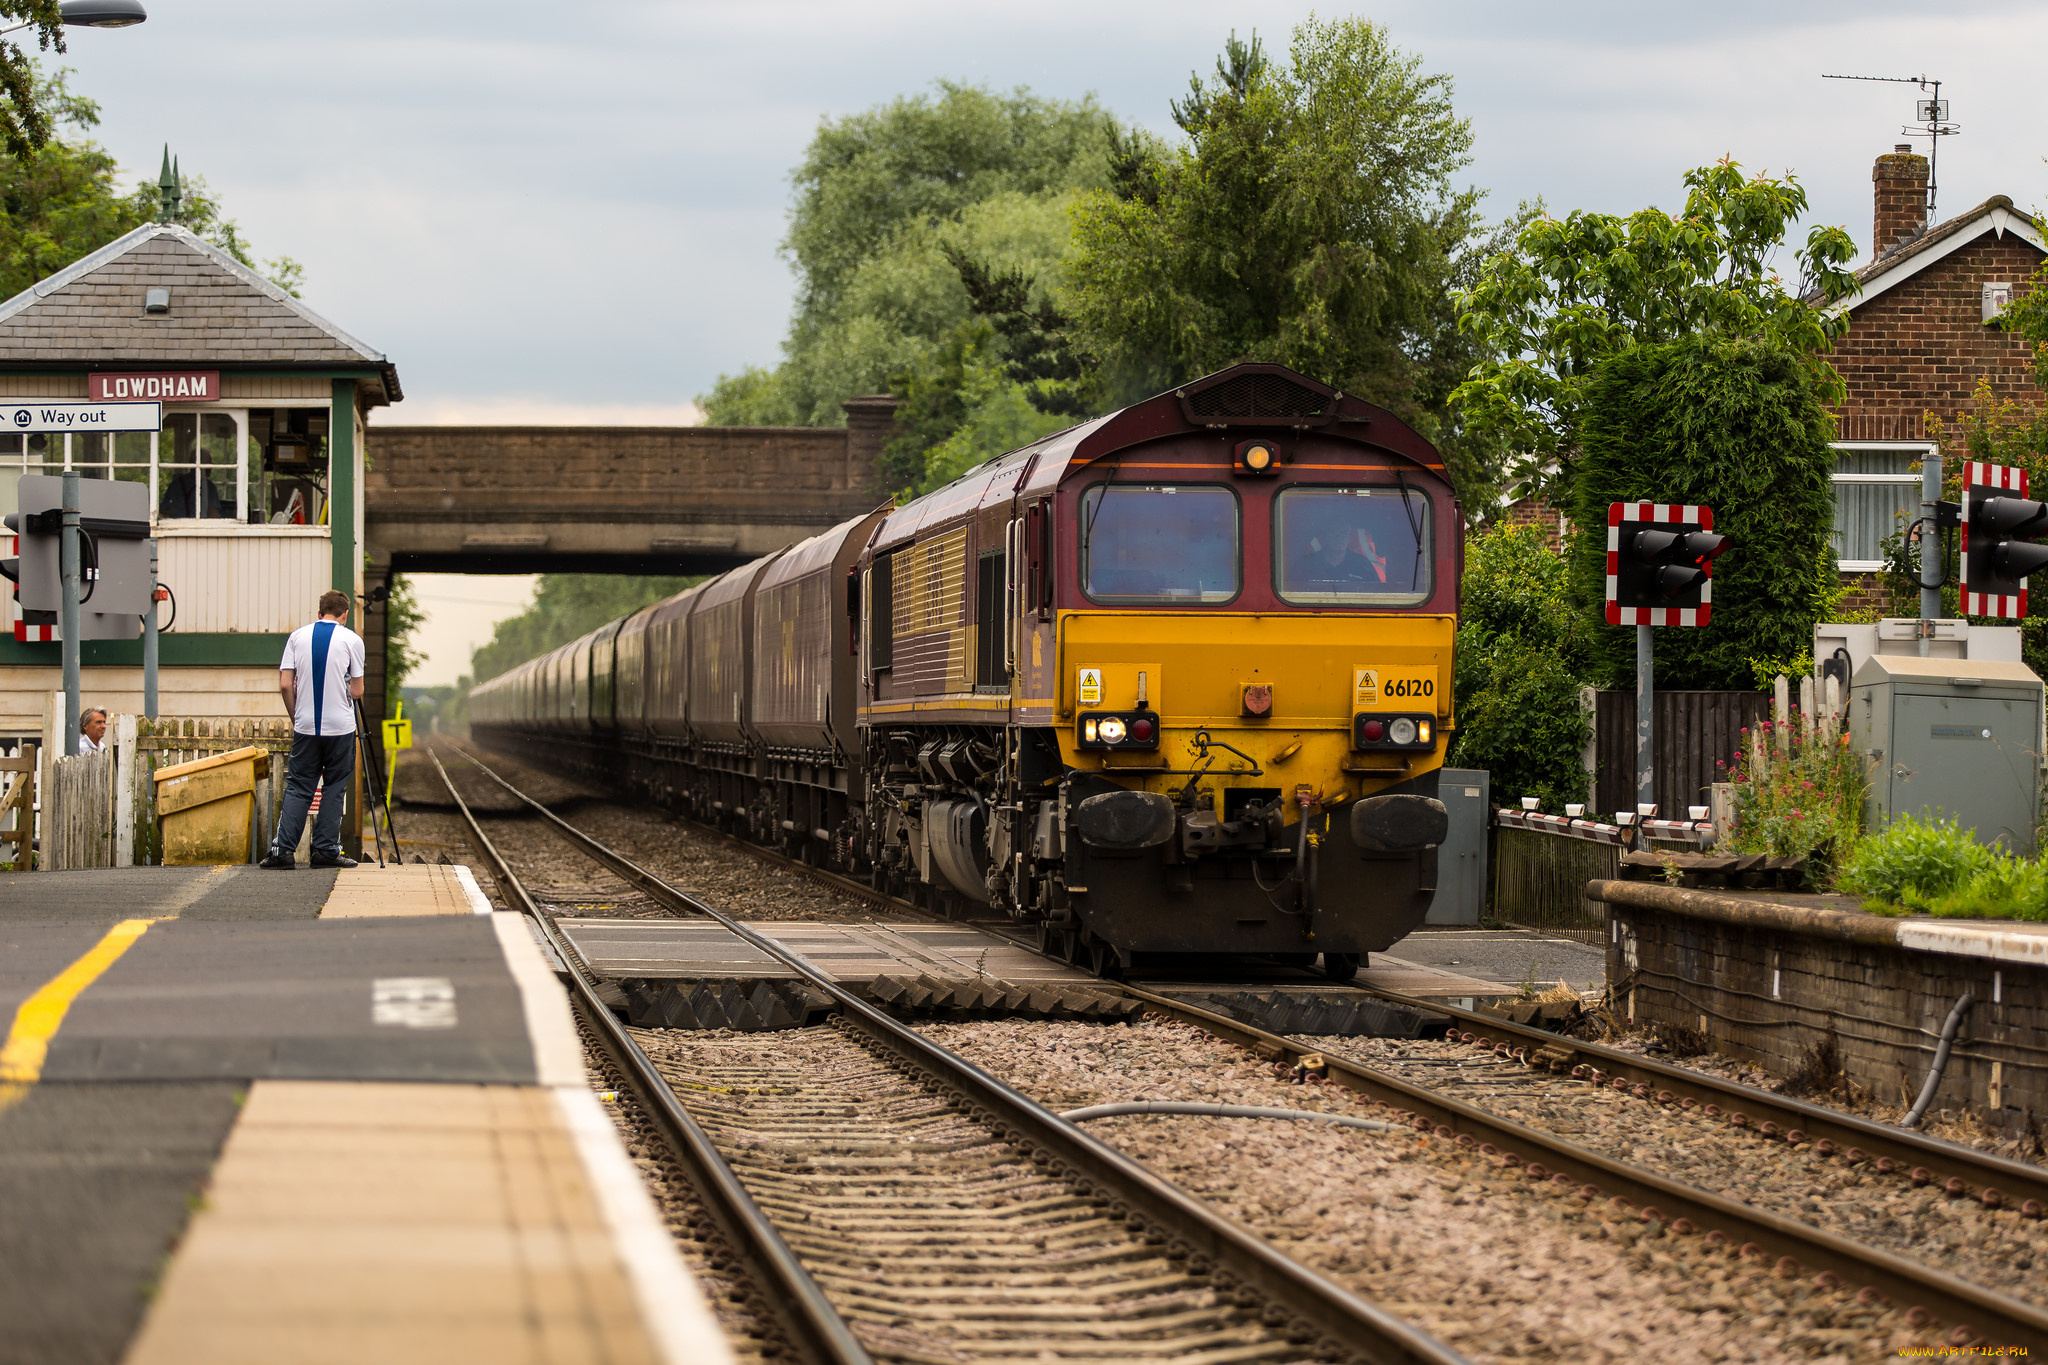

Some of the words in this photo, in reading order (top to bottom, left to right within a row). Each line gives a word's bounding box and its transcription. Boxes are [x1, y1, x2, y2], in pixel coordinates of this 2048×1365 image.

[103, 376, 207, 398] LOWDHAM
[41, 409, 75, 426] Way
[80, 410, 106, 423] out
[1384, 679, 1434, 697] 66120
[388, 723, 406, 745] T
